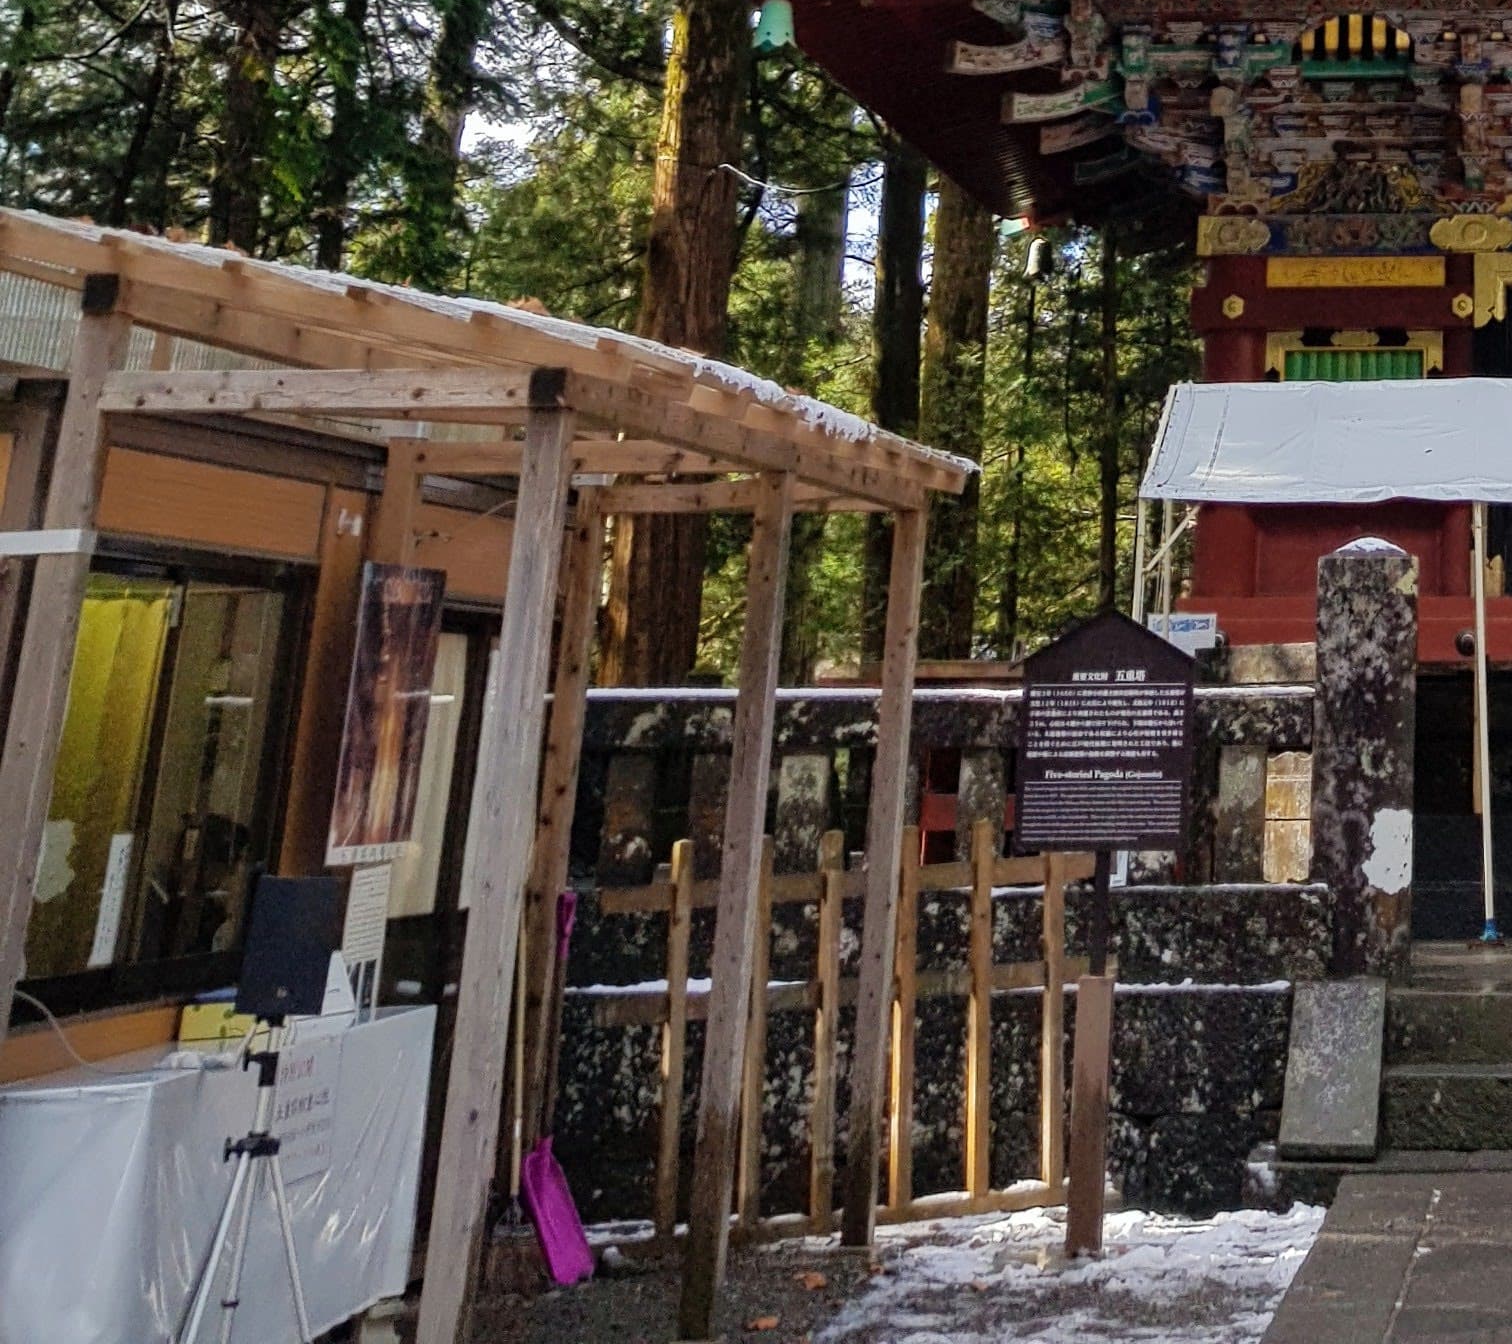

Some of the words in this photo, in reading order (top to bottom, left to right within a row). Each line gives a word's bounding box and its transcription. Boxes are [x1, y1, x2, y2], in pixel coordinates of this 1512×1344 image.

[1115, 669, 1147, 682] 五重塔
[1094, 769, 1124, 780] Pagoda
